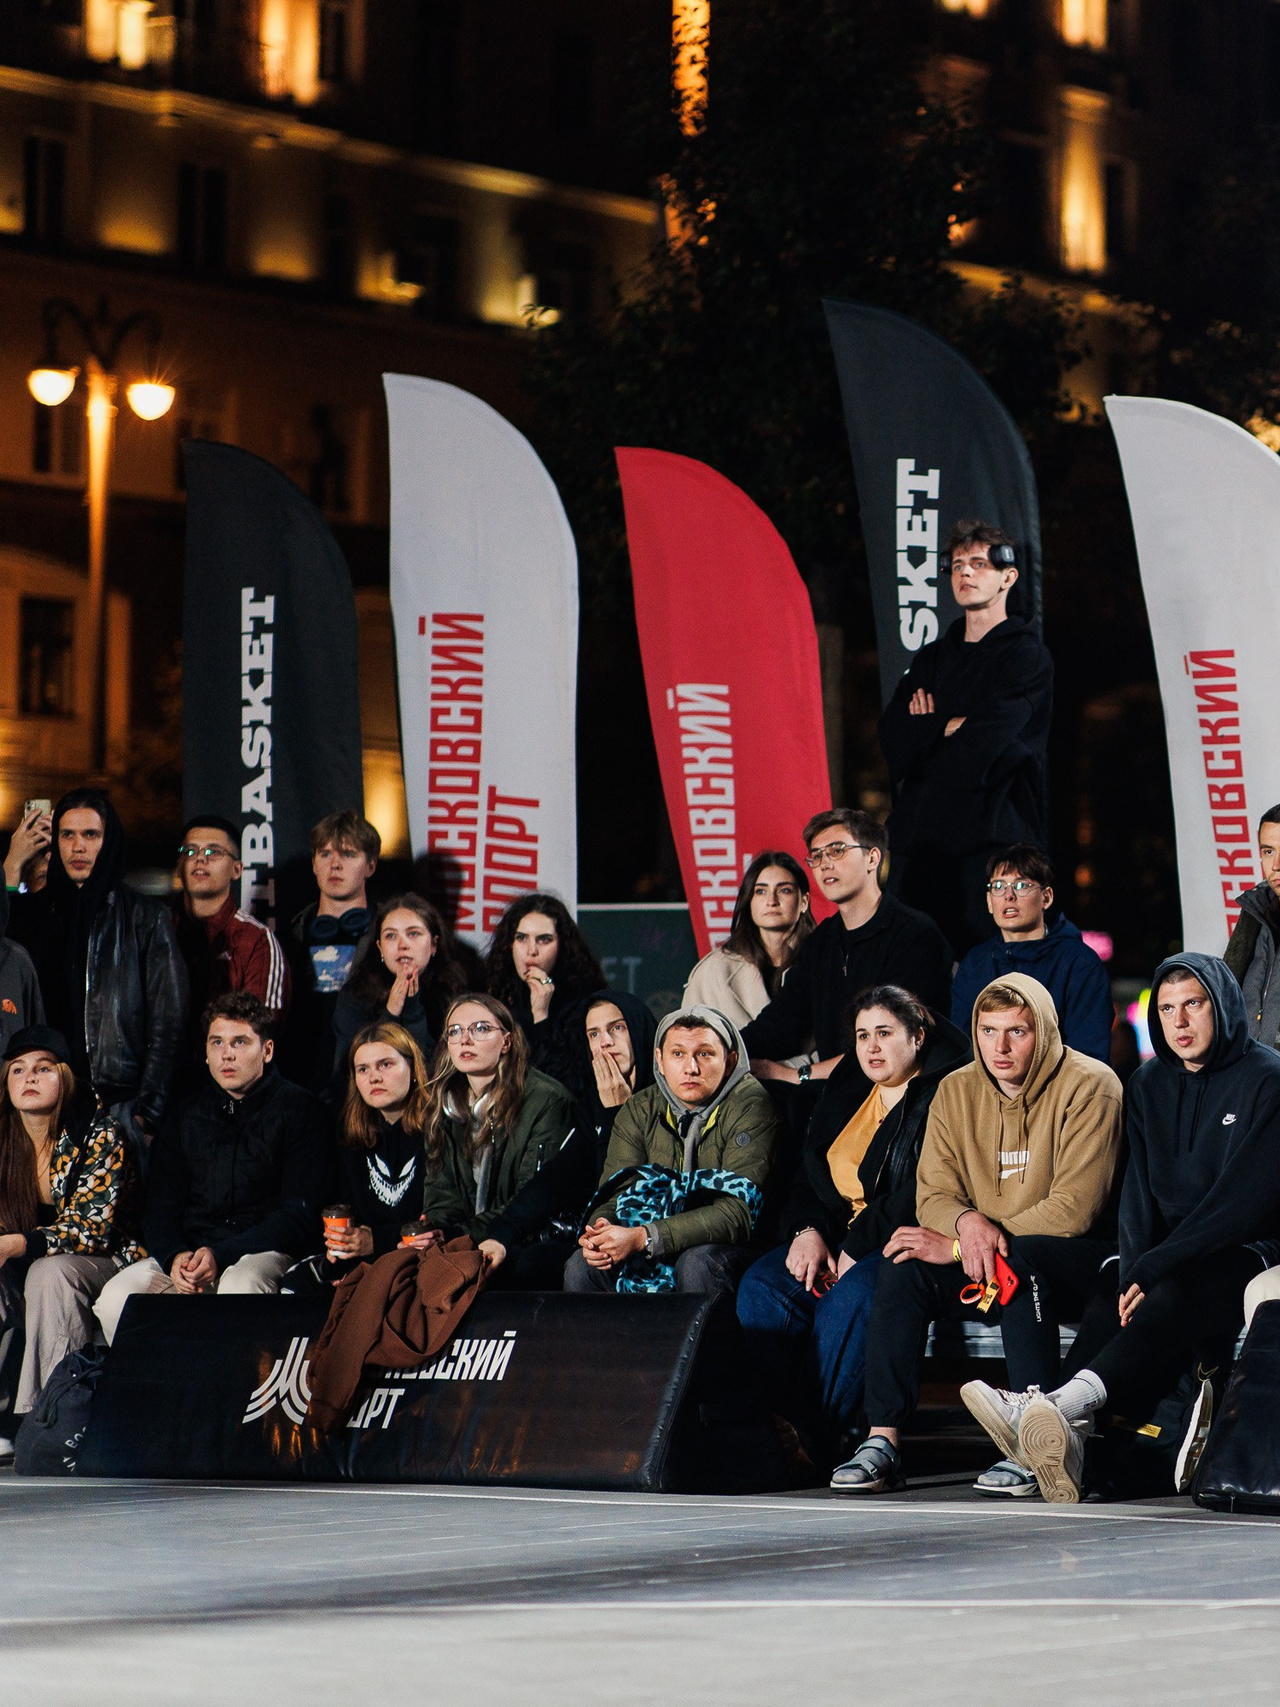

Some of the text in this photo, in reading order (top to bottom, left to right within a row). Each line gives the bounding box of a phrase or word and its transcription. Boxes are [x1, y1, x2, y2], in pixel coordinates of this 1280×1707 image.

[896, 458, 940, 652] SKET
[241, 586, 276, 913] TBASKET
[1184, 649, 1257, 939] СКОВСКИЙ
